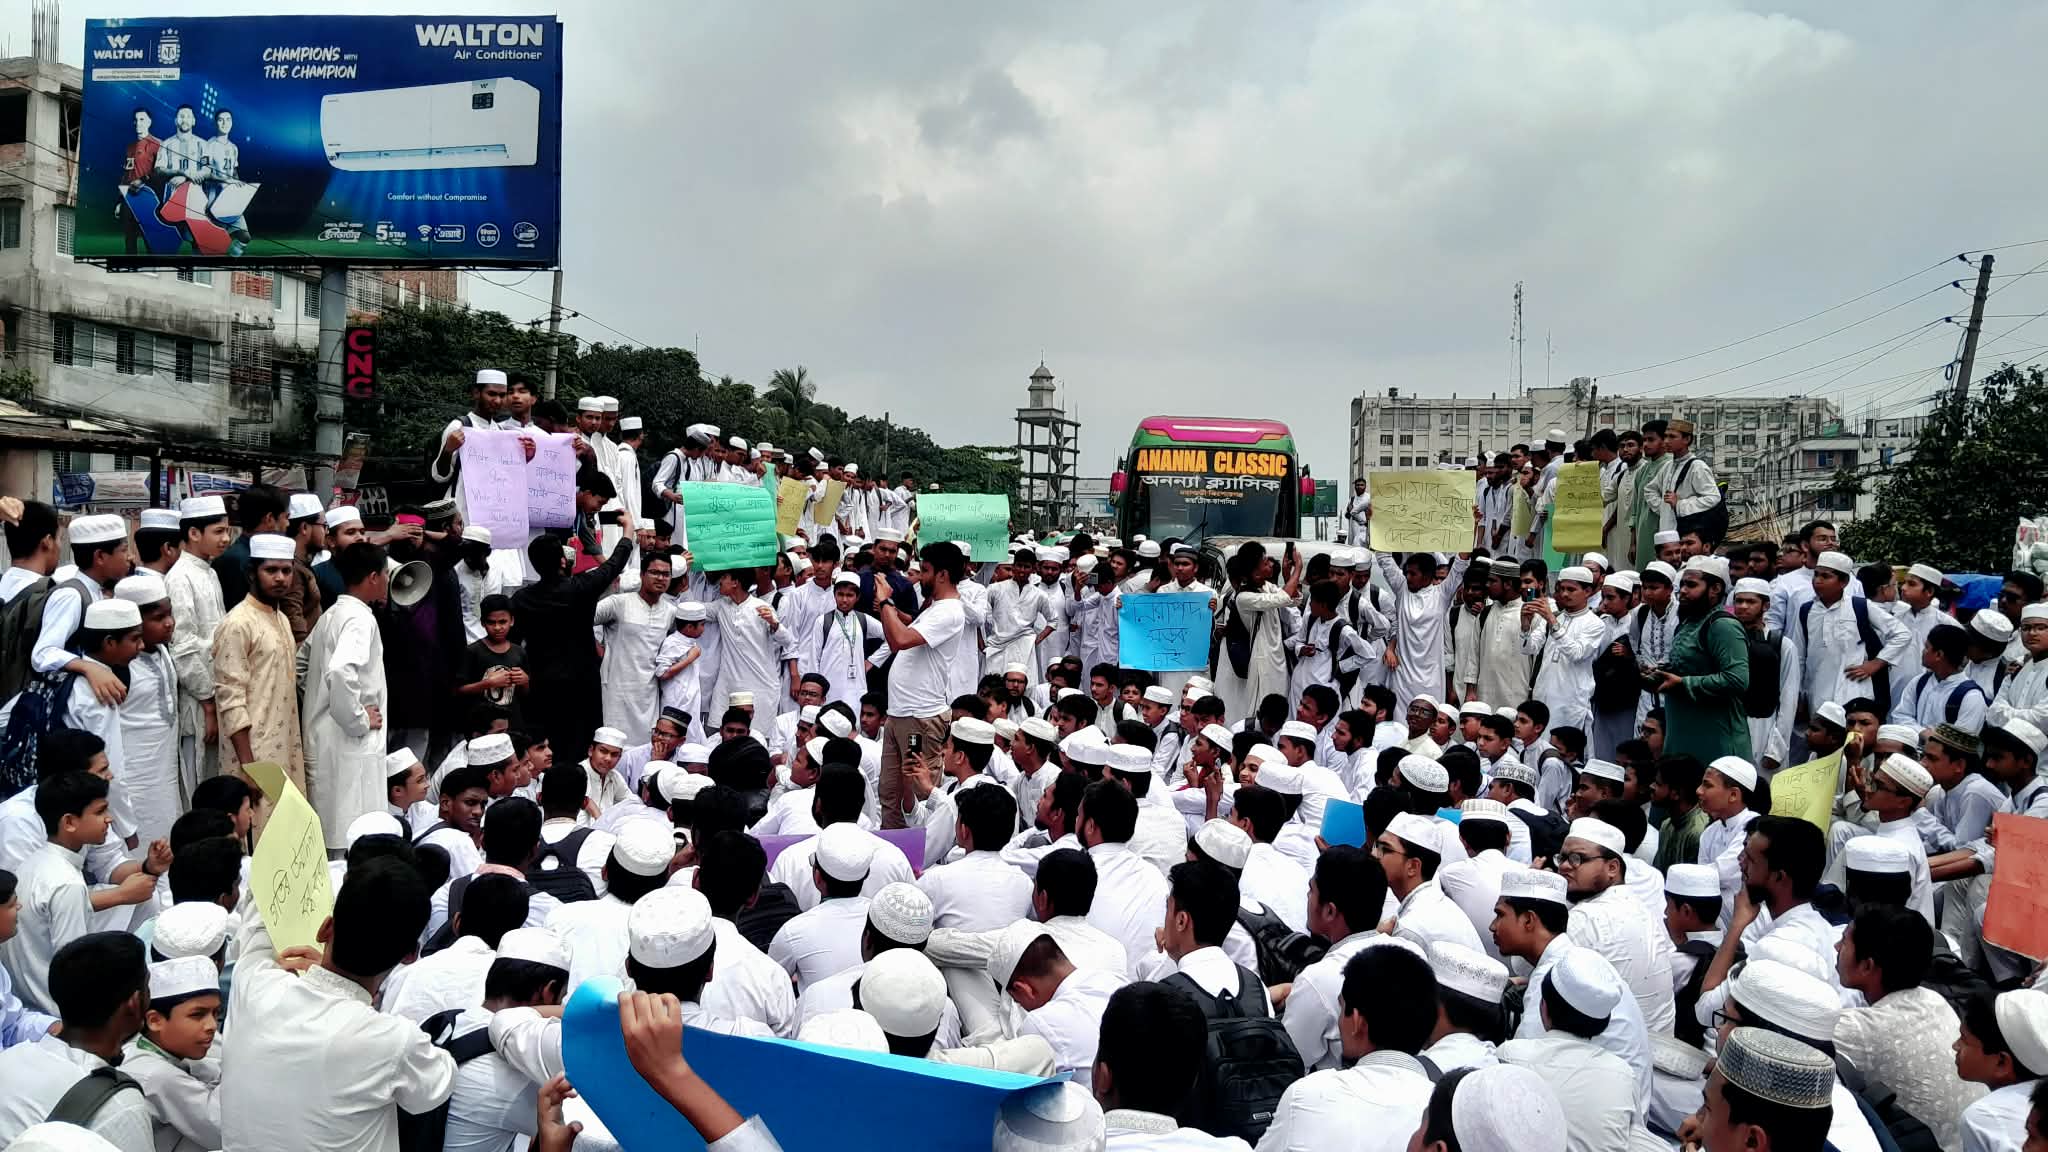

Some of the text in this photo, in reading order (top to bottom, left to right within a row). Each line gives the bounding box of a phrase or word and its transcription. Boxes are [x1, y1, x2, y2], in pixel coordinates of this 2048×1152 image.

[415, 23, 543, 46] WALTON
[93, 49, 144, 59] WALTON
[263, 45, 340, 62] CHAMPIONS
[454, 49, 542, 60] Air Conditioner
[264, 64, 357, 79] THE CHAMPION
[387, 192, 414, 200] Comfort
[444, 192, 487, 202] Compromise
[347, 329, 373, 398] CNG
[1137, 449, 1288, 477] ANANNA CLASSIC
[1141, 475, 1200, 488] অনন্যা
